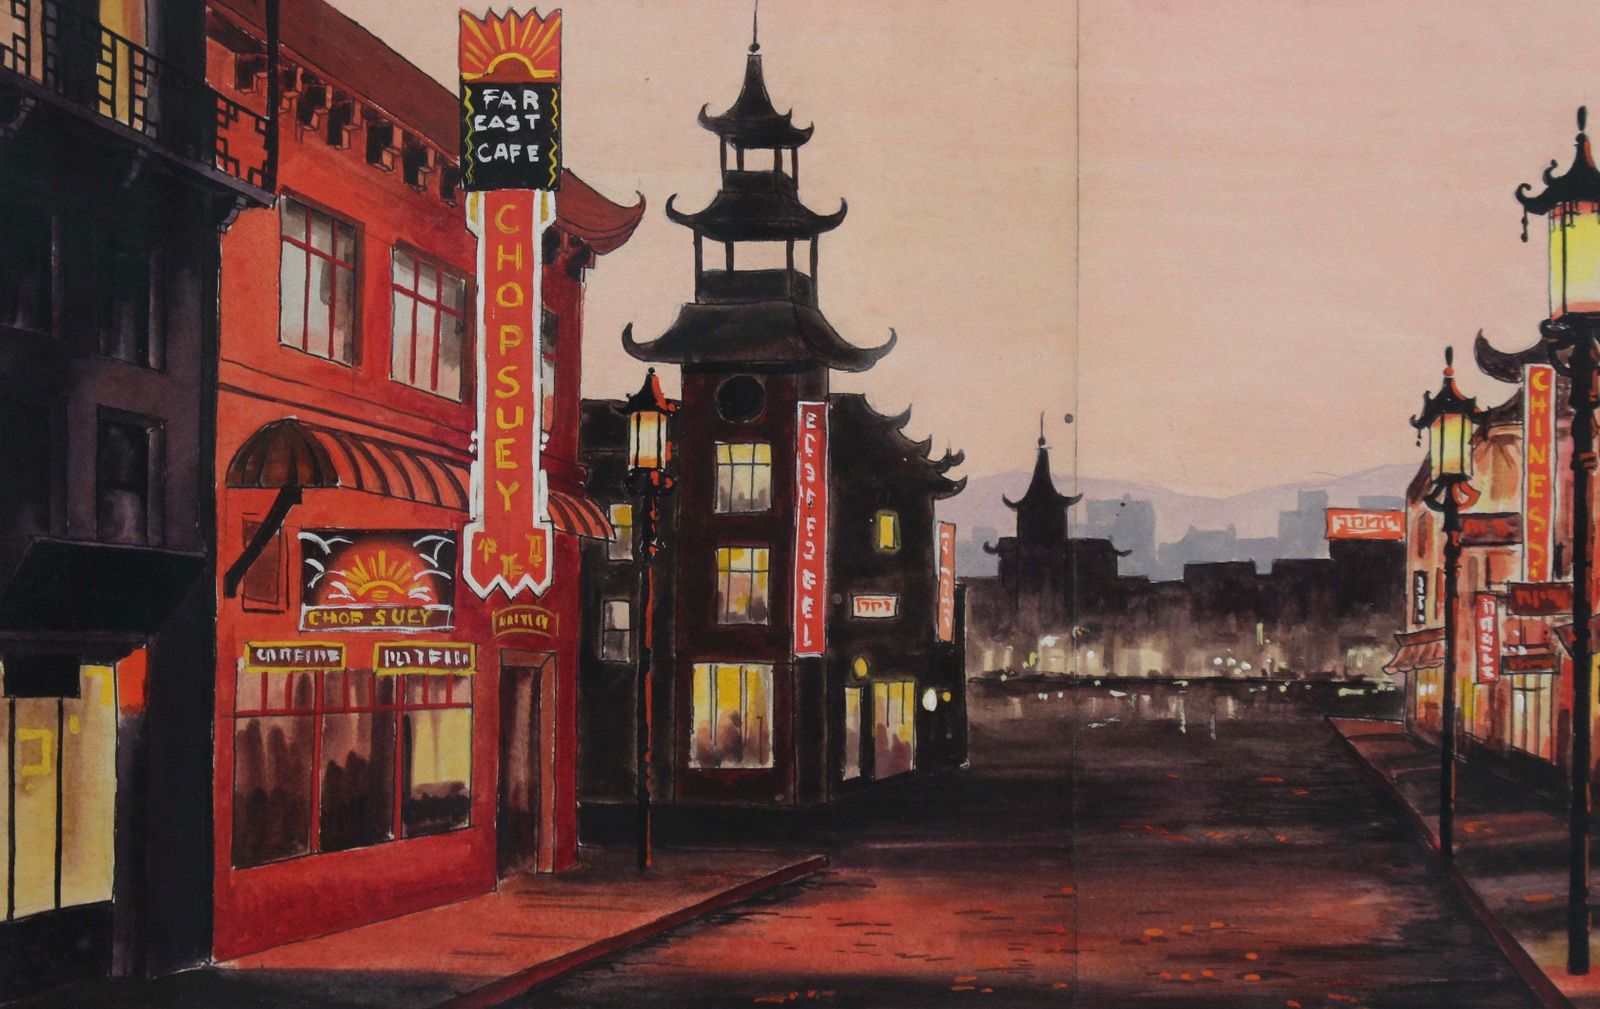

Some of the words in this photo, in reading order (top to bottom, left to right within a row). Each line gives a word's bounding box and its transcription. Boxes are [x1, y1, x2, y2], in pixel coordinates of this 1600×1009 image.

[482, 88, 539, 110] FAR
[474, 114, 540, 132] EAST
[476, 142, 540, 164] CAFE
[371, 608, 433, 627] SUEY
